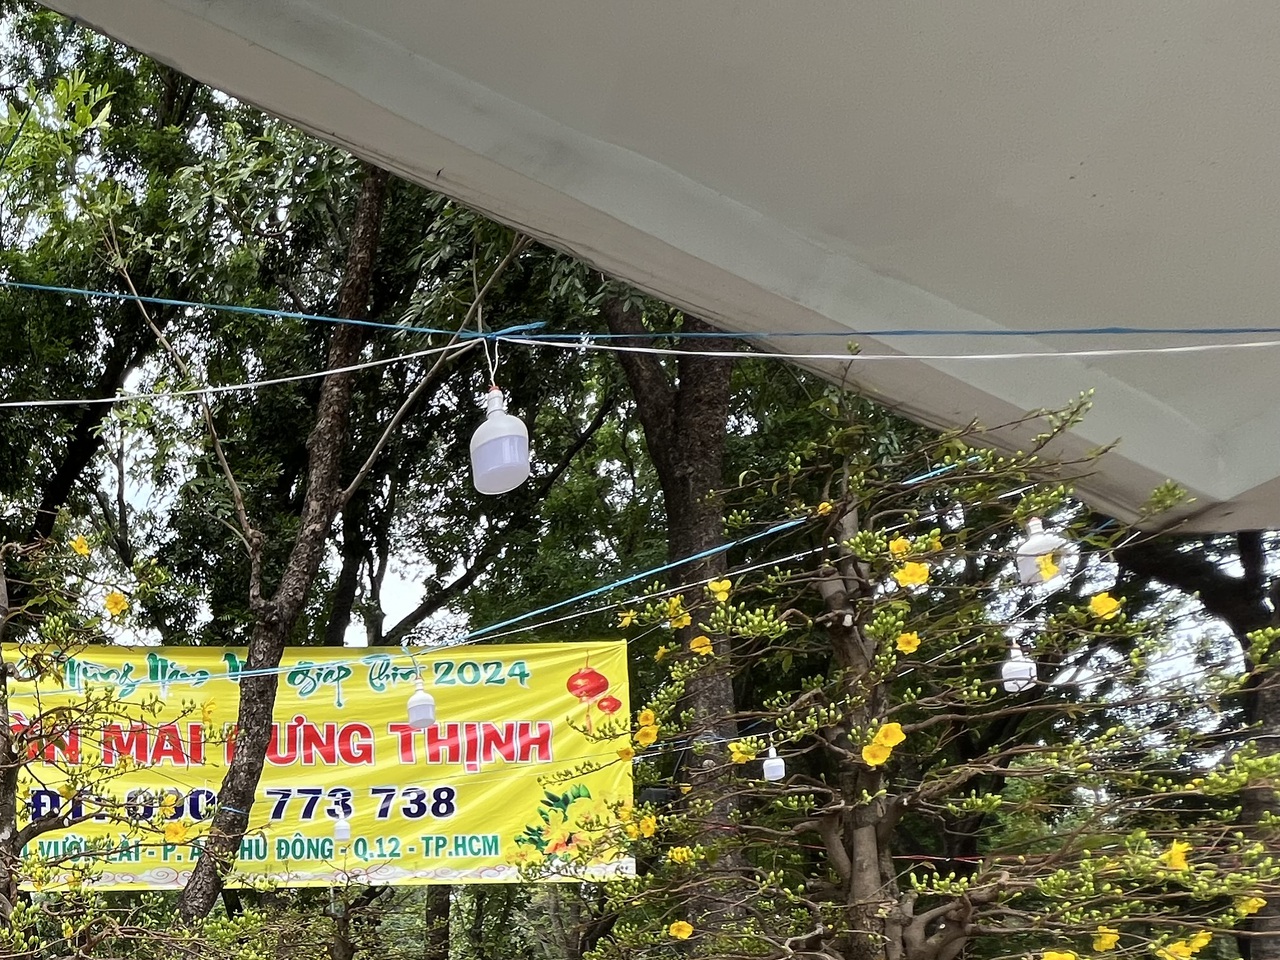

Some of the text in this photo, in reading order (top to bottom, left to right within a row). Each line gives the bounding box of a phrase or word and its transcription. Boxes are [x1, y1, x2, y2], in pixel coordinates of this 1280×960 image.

[434, 661, 530, 685] 2024
[102, 723, 203, 765] MAI
[389, 722, 552, 772] THỊNH
[266, 788, 352, 819] 773
[371, 786, 455, 818] 738
[276, 832, 333, 860] ĐÔNG
[354, 837, 401, 862] Q.12
[421, 835, 500, 857] TP.HCM
